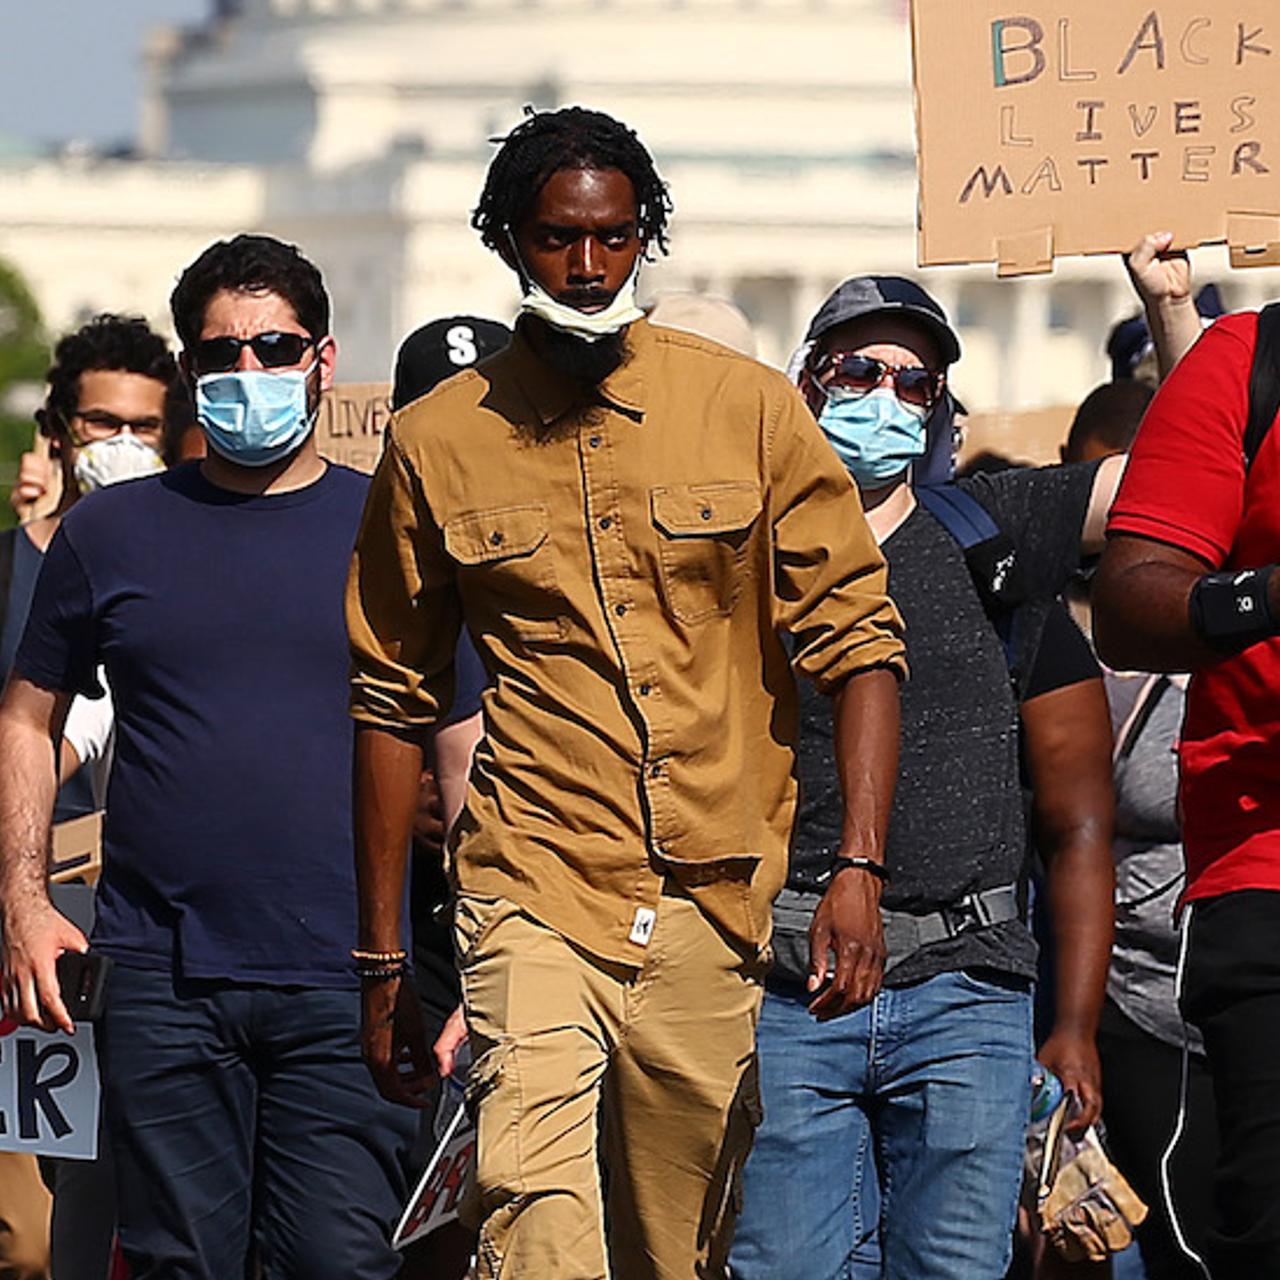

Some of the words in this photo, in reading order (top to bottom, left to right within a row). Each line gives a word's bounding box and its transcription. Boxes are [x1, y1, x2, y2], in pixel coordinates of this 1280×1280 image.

[991, 11, 1273, 88] BLACK
[1000, 96, 1257, 146] LIVES
[958, 142, 1269, 203] MATTER
[447, 325, 478, 366] S
[327, 396, 391, 438] LIVE
